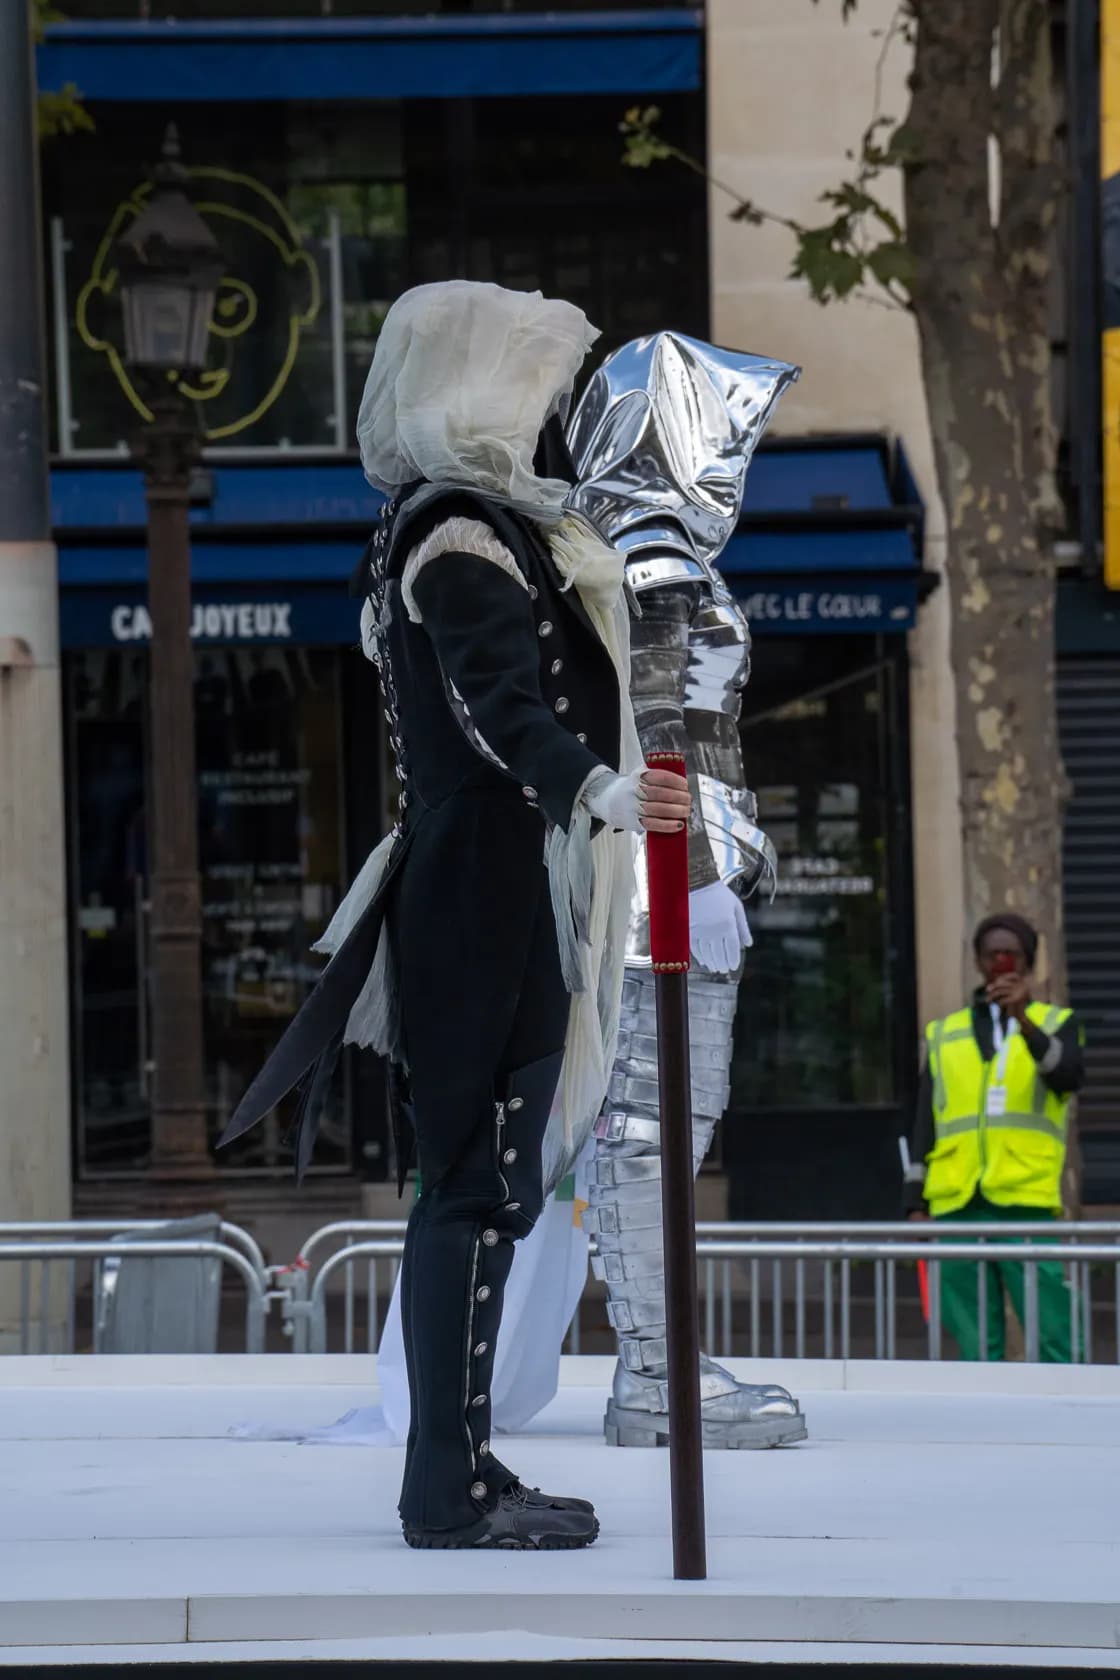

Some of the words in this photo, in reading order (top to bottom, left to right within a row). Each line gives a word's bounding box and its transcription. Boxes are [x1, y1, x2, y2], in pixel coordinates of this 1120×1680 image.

[112, 605, 153, 641] CA
[189, 603, 291, 638] JOYEUX
[785, 593, 813, 620] LE
